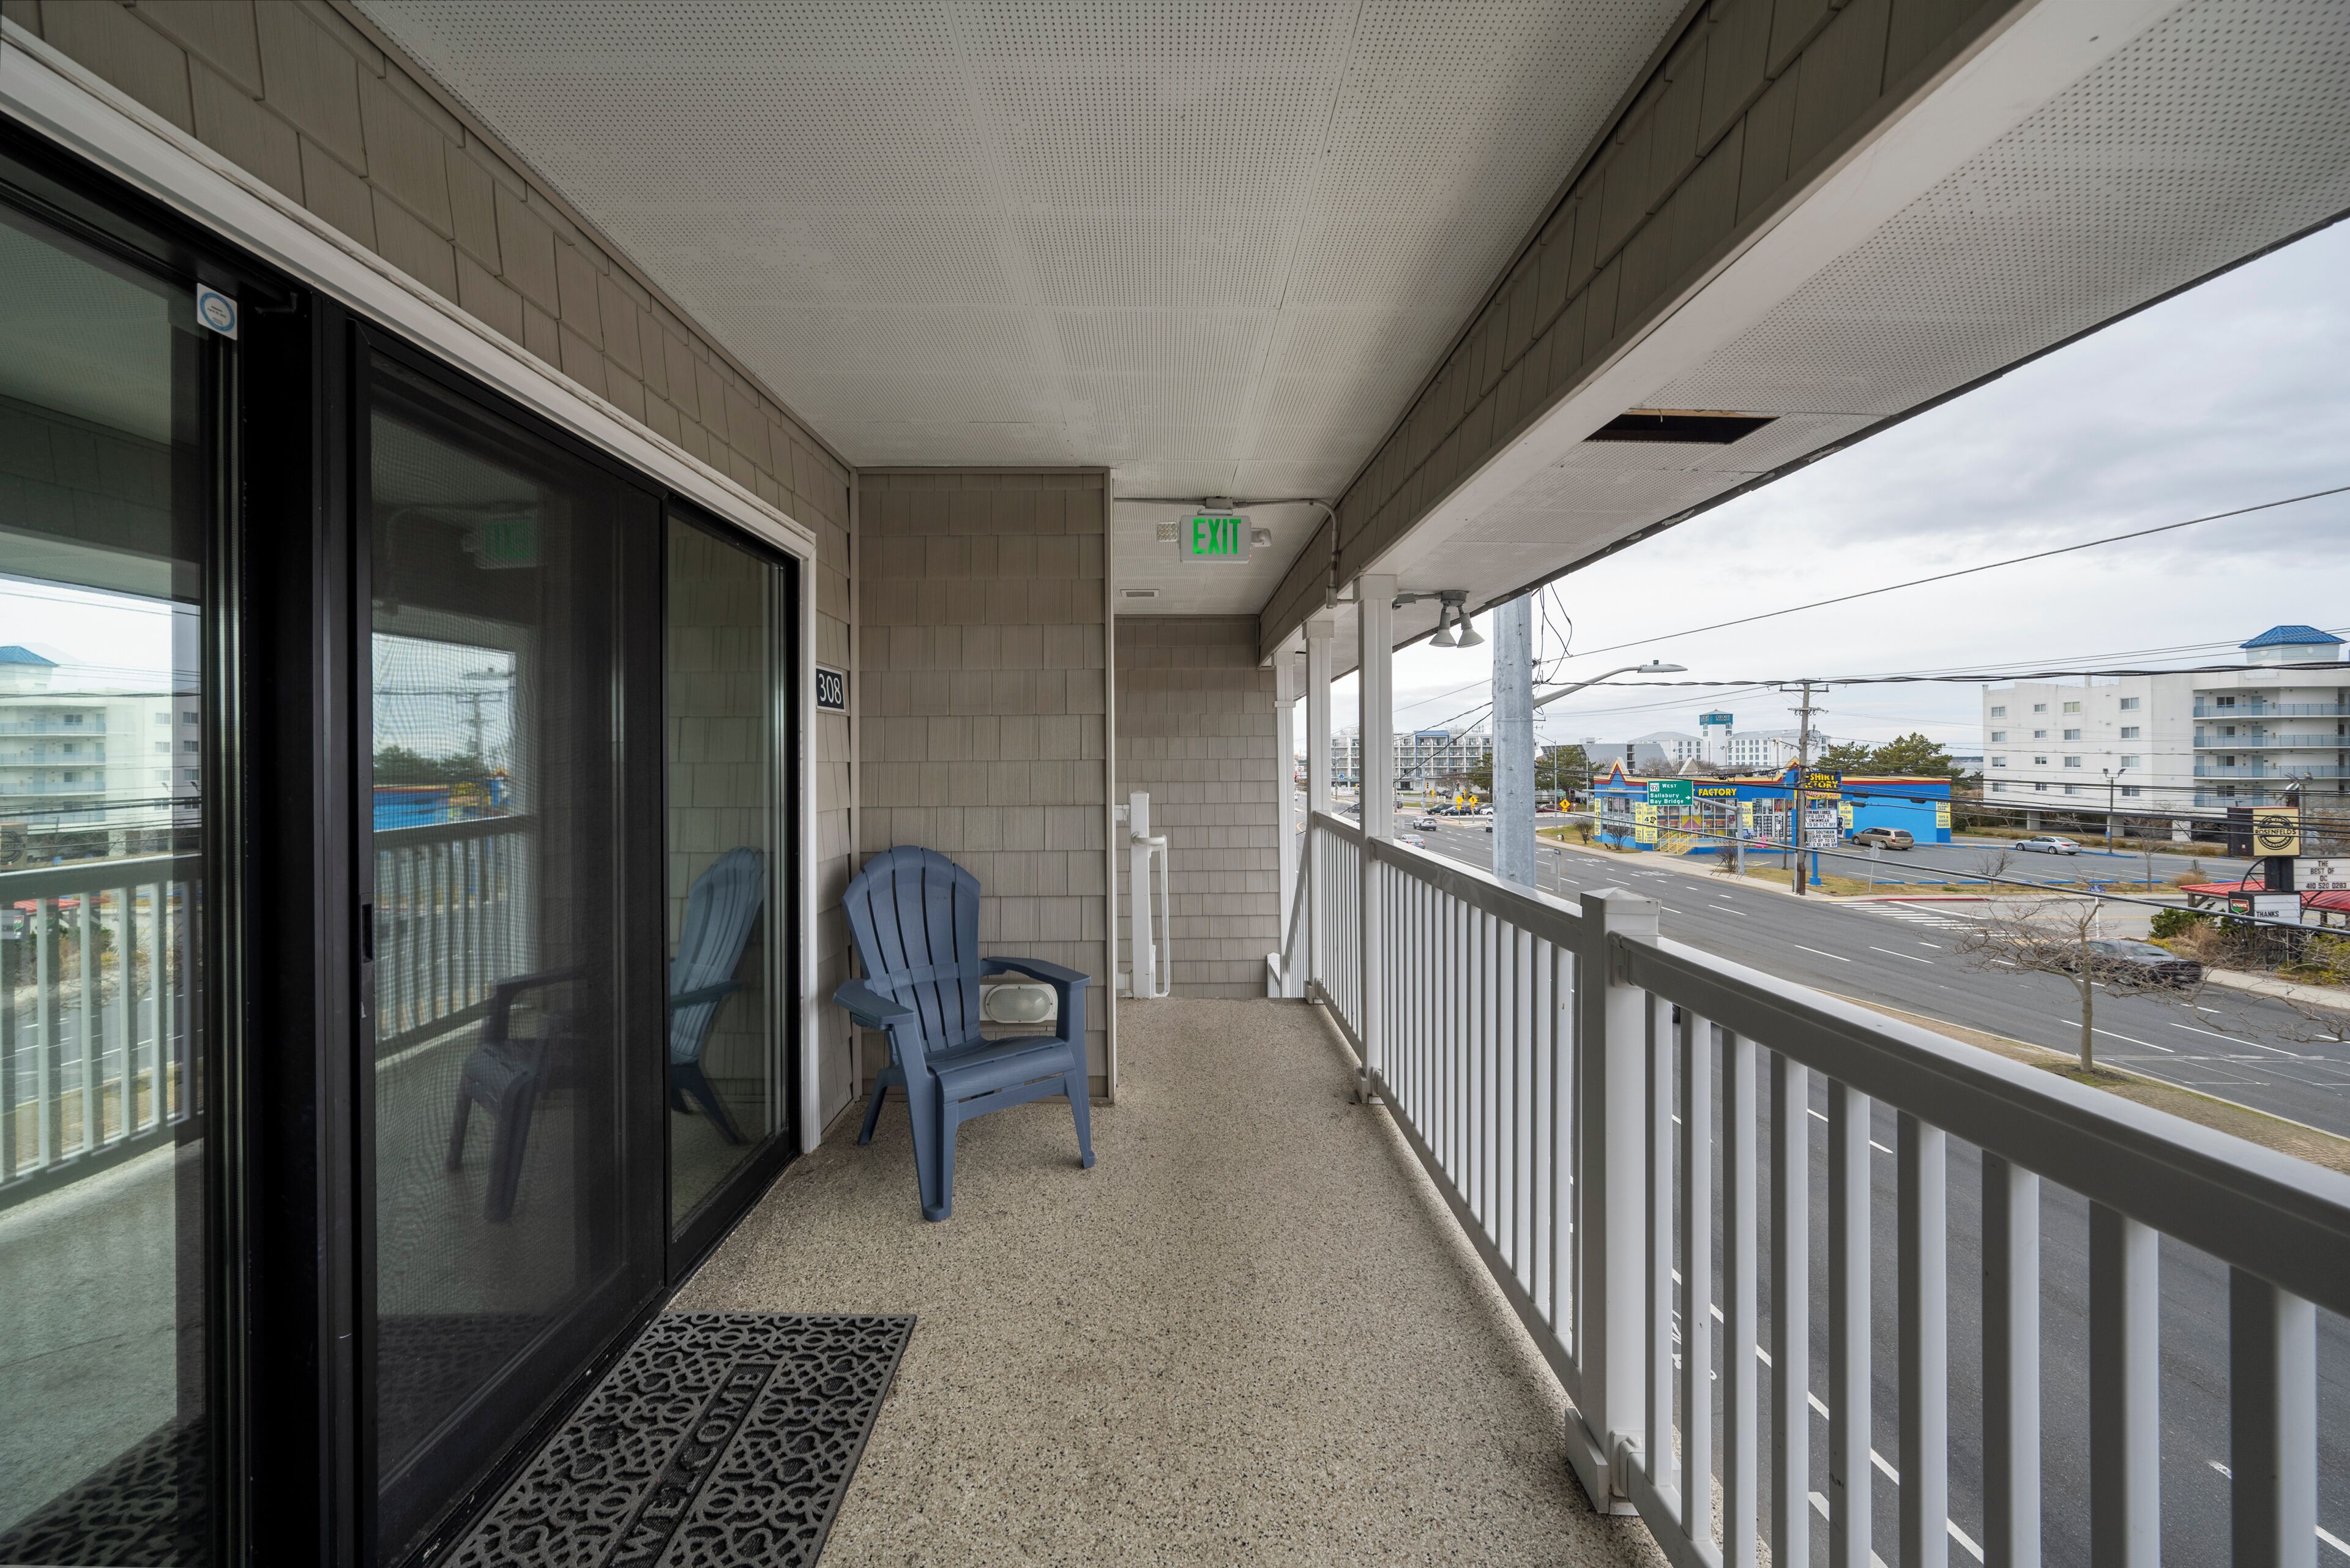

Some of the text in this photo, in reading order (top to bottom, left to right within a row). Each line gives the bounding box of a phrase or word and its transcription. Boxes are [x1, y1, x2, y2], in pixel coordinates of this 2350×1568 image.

[1193, 518, 1242, 554] EXIT
[818, 673, 842, 704] 308
[1698, 788, 1737, 796] FACTORY
[610, 1373, 764, 1568] WELCOME
